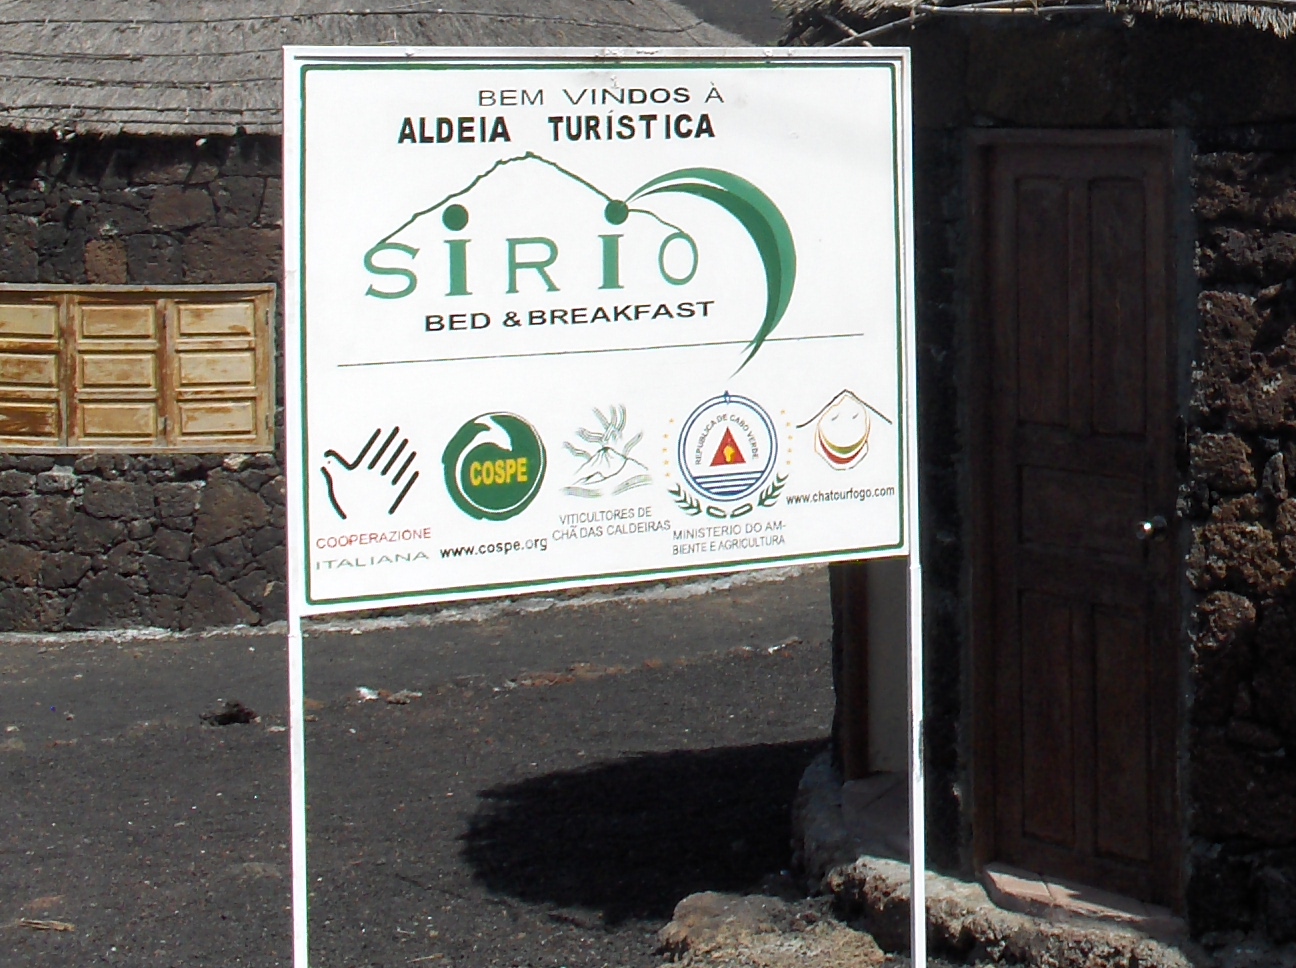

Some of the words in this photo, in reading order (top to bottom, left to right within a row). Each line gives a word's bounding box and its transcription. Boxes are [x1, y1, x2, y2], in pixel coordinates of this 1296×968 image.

[477, 89, 545, 107] BEM
[562, 86, 691, 106] VINDOS
[397, 116, 512, 144] ALDEIA
[547, 110, 716, 142] TURÍSTICA
[425, 311, 491, 332] BED
[528, 300, 716, 326] BREAKFAST
[716, 413, 728, 423] DE
[729, 414, 750, 432] CABO
[746, 430, 759, 460] VERDE
[469, 457, 528, 487] COSPE
[785, 486, 895, 506] www.chatourfogo.com
[559, 507, 635, 525] VITICULTORES
[637, 506, 652, 518] DE
[315, 527, 432, 549] COOPERAZIONE
[579, 525, 603, 539] DAS
[606, 519, 671, 536] CALDEIRAS
[672, 524, 742, 541] MINISTERIO
[745, 522, 762, 534] DO
[439, 536, 548, 559] www.cospe.org
[672, 542, 707, 556] BIENTE
[709, 541, 717, 552] E
[717, 534, 786, 551] AGRICULTURA
[315, 550, 430, 571] ITALIANA
